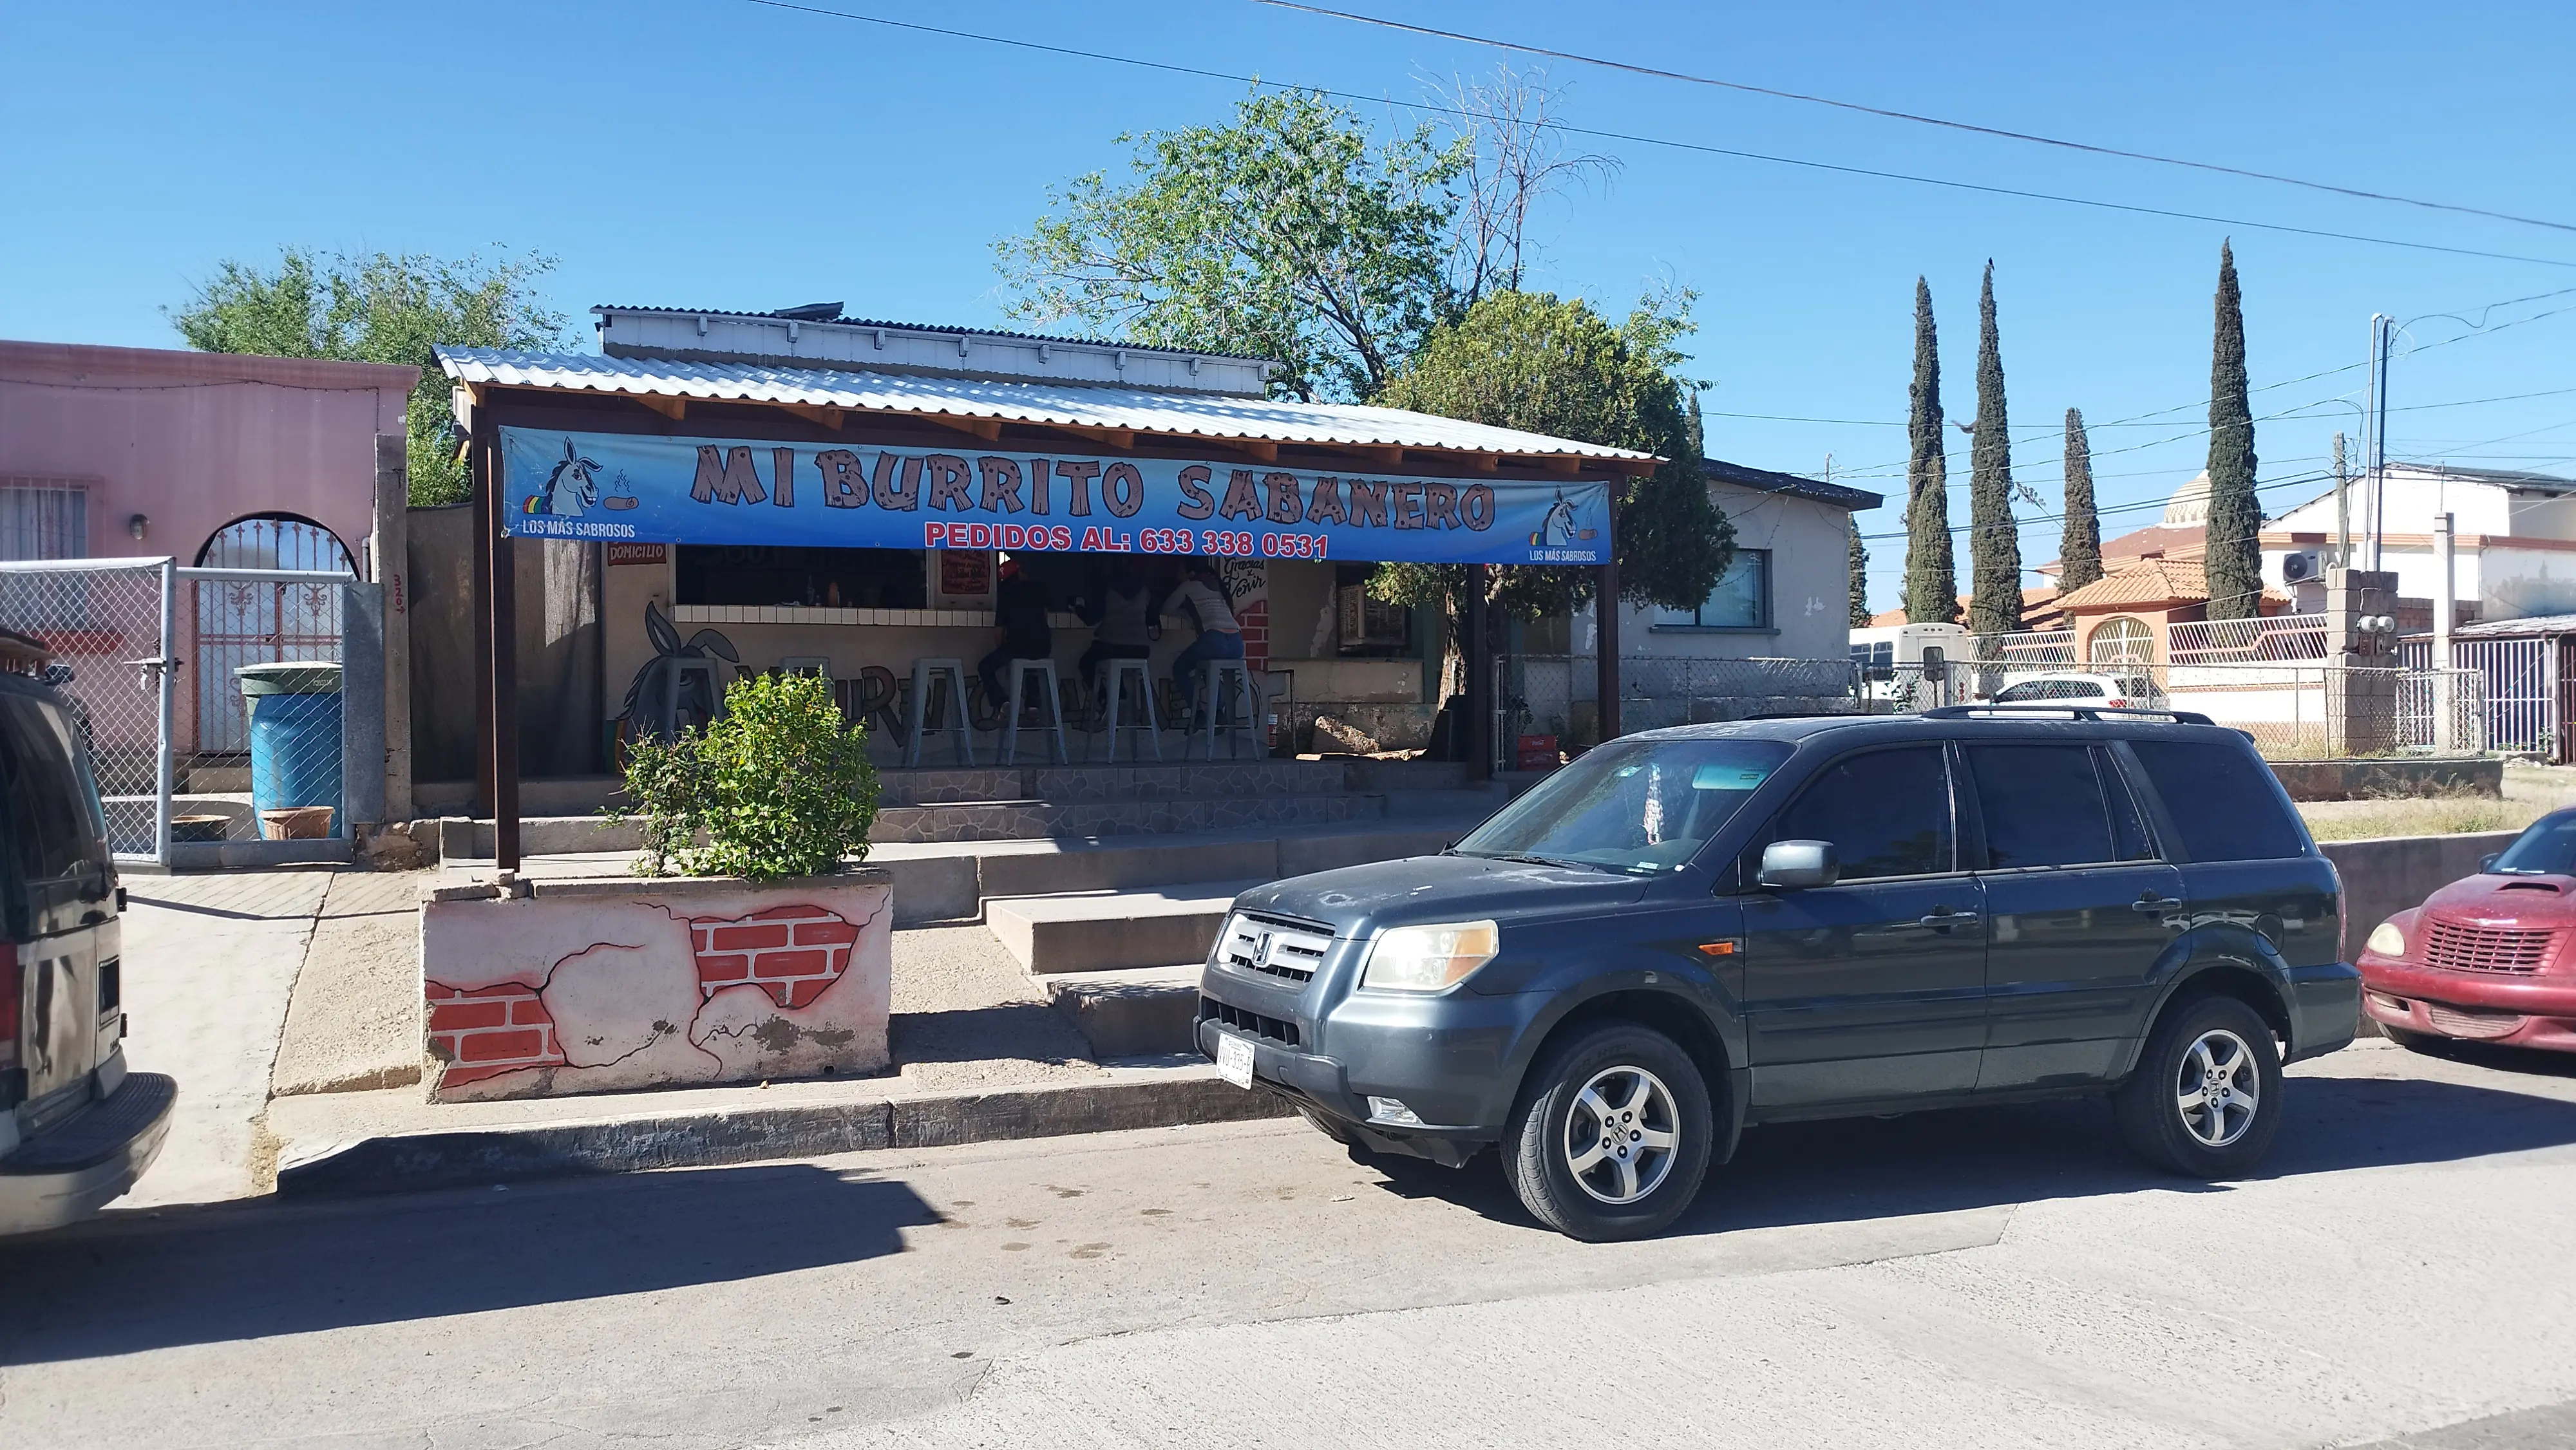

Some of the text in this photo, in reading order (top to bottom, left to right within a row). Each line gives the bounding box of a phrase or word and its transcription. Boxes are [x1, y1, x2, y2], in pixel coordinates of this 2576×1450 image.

[690, 444, 1495, 532] MI BURRITO SABANERO
[522, 520, 544, 534] LOS
[576, 522, 636, 538] SABROSOS
[925, 522, 1328, 558] PEDIDOS AL: 633 338 0531
[610, 545, 664, 561] DOMICILIO
[1530, 548, 1597, 562] LOS MÁS SABROSOS
[1224, 556, 1265, 579] Gracias
[1223, 575, 1266, 598] Venir
